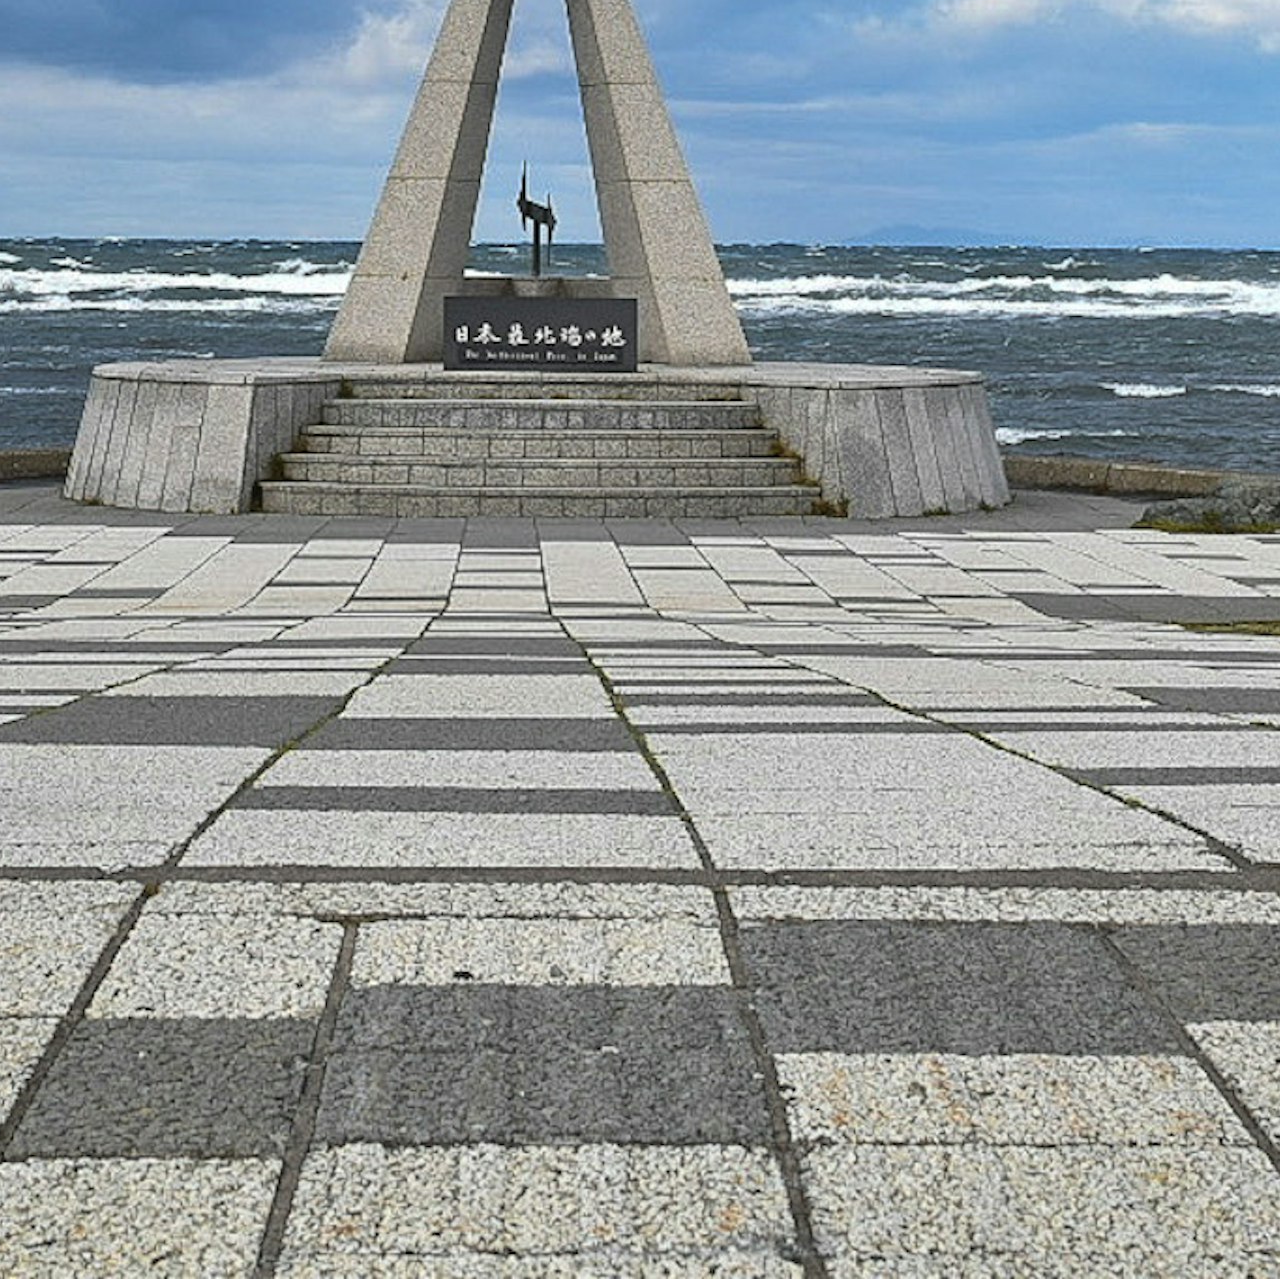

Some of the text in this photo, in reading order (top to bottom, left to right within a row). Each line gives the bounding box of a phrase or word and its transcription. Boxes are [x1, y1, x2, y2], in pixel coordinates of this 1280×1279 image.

[455, 322, 627, 347] 日本最北端の地
